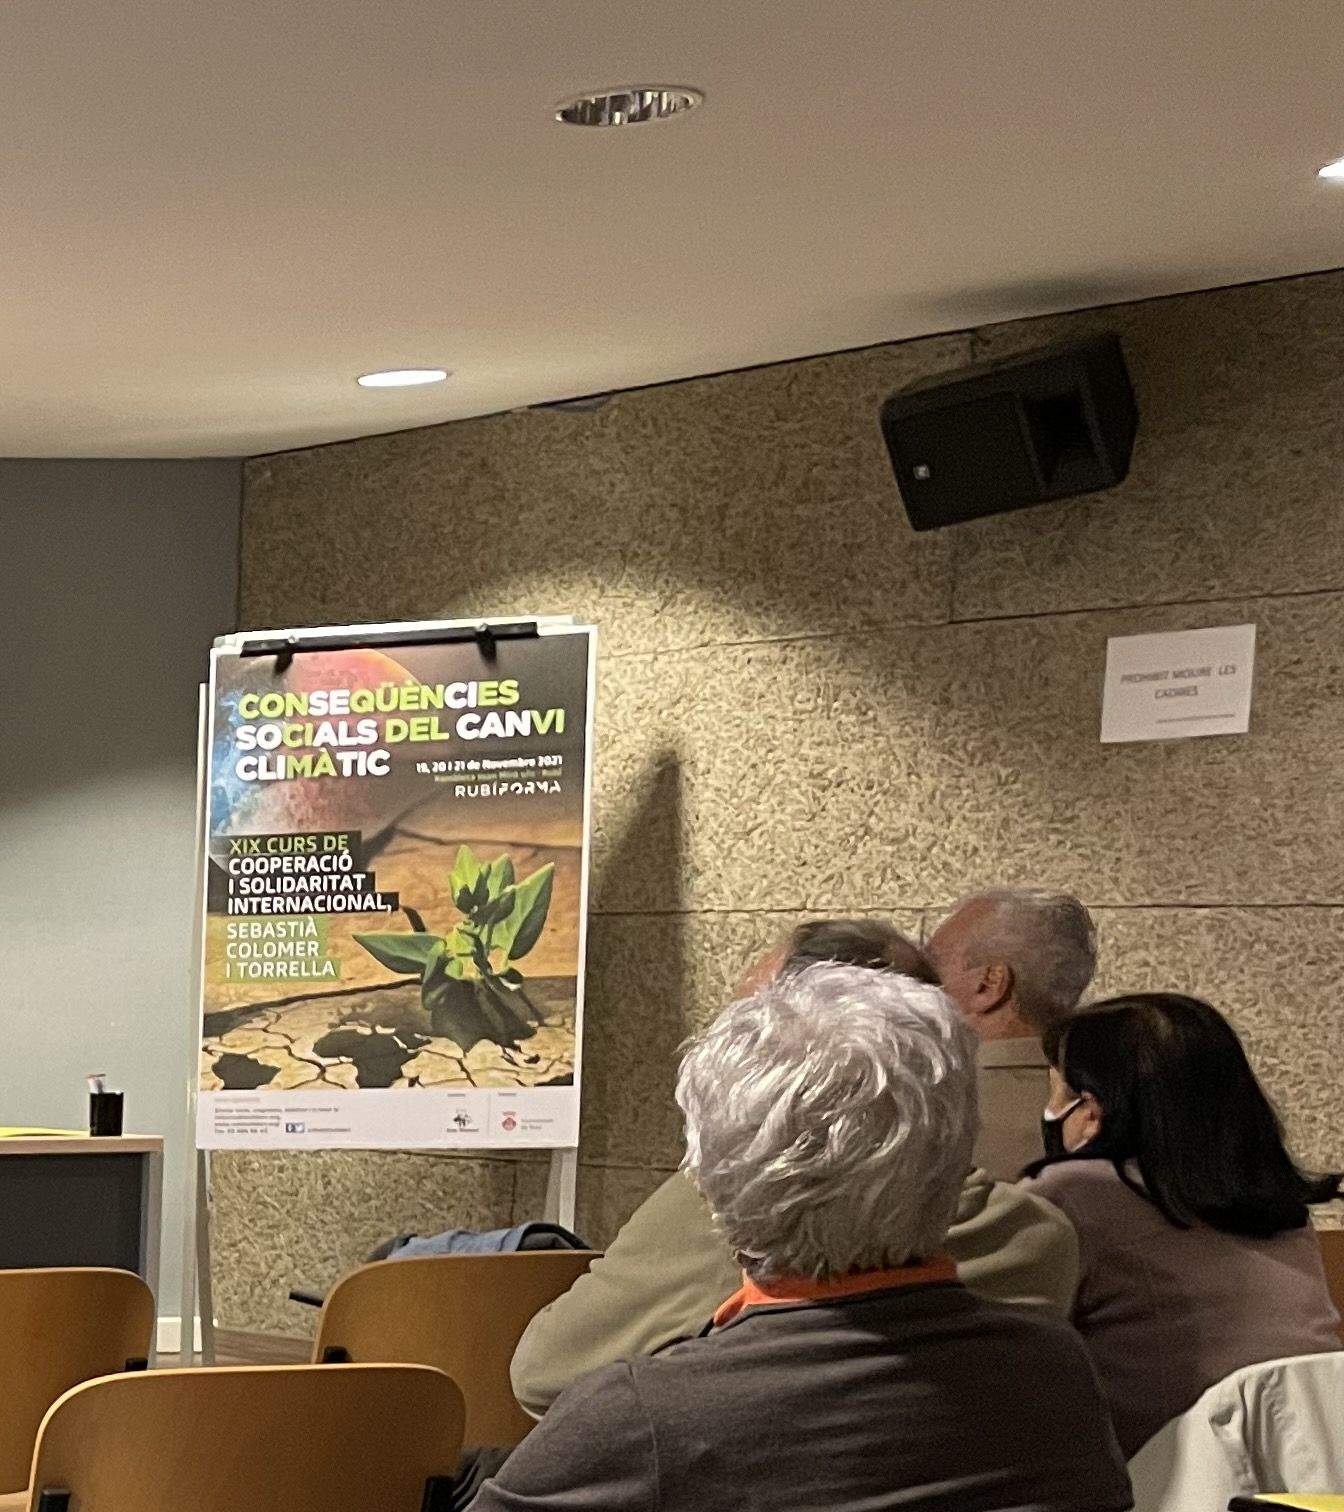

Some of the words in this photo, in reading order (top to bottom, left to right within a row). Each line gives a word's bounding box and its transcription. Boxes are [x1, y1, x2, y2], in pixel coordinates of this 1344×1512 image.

[238, 679, 520, 719] CONSEQÜÈNCIES
[235, 719, 379, 750] SOCIALS
[385, 716, 450, 743] DEL
[456, 708, 565, 740] CANVI
[235, 747, 391, 781] CLIMÀTIC
[229, 838, 261, 855] XIX
[267, 836, 317, 853] CURS
[323, 834, 349, 851] DE
[228, 848, 353, 875] COOPERACIÓ
[228, 878, 234, 895] I
[240, 873, 366, 895] SOLIDARITAT
[227, 893, 392, 915] INTERNACIONAL,
[226, 916, 318, 939] SEBASTIÀ
[226, 941, 319, 959] COLOMER
[226, 962, 231, 978] I
[237, 961, 336, 978] TORRELLA
